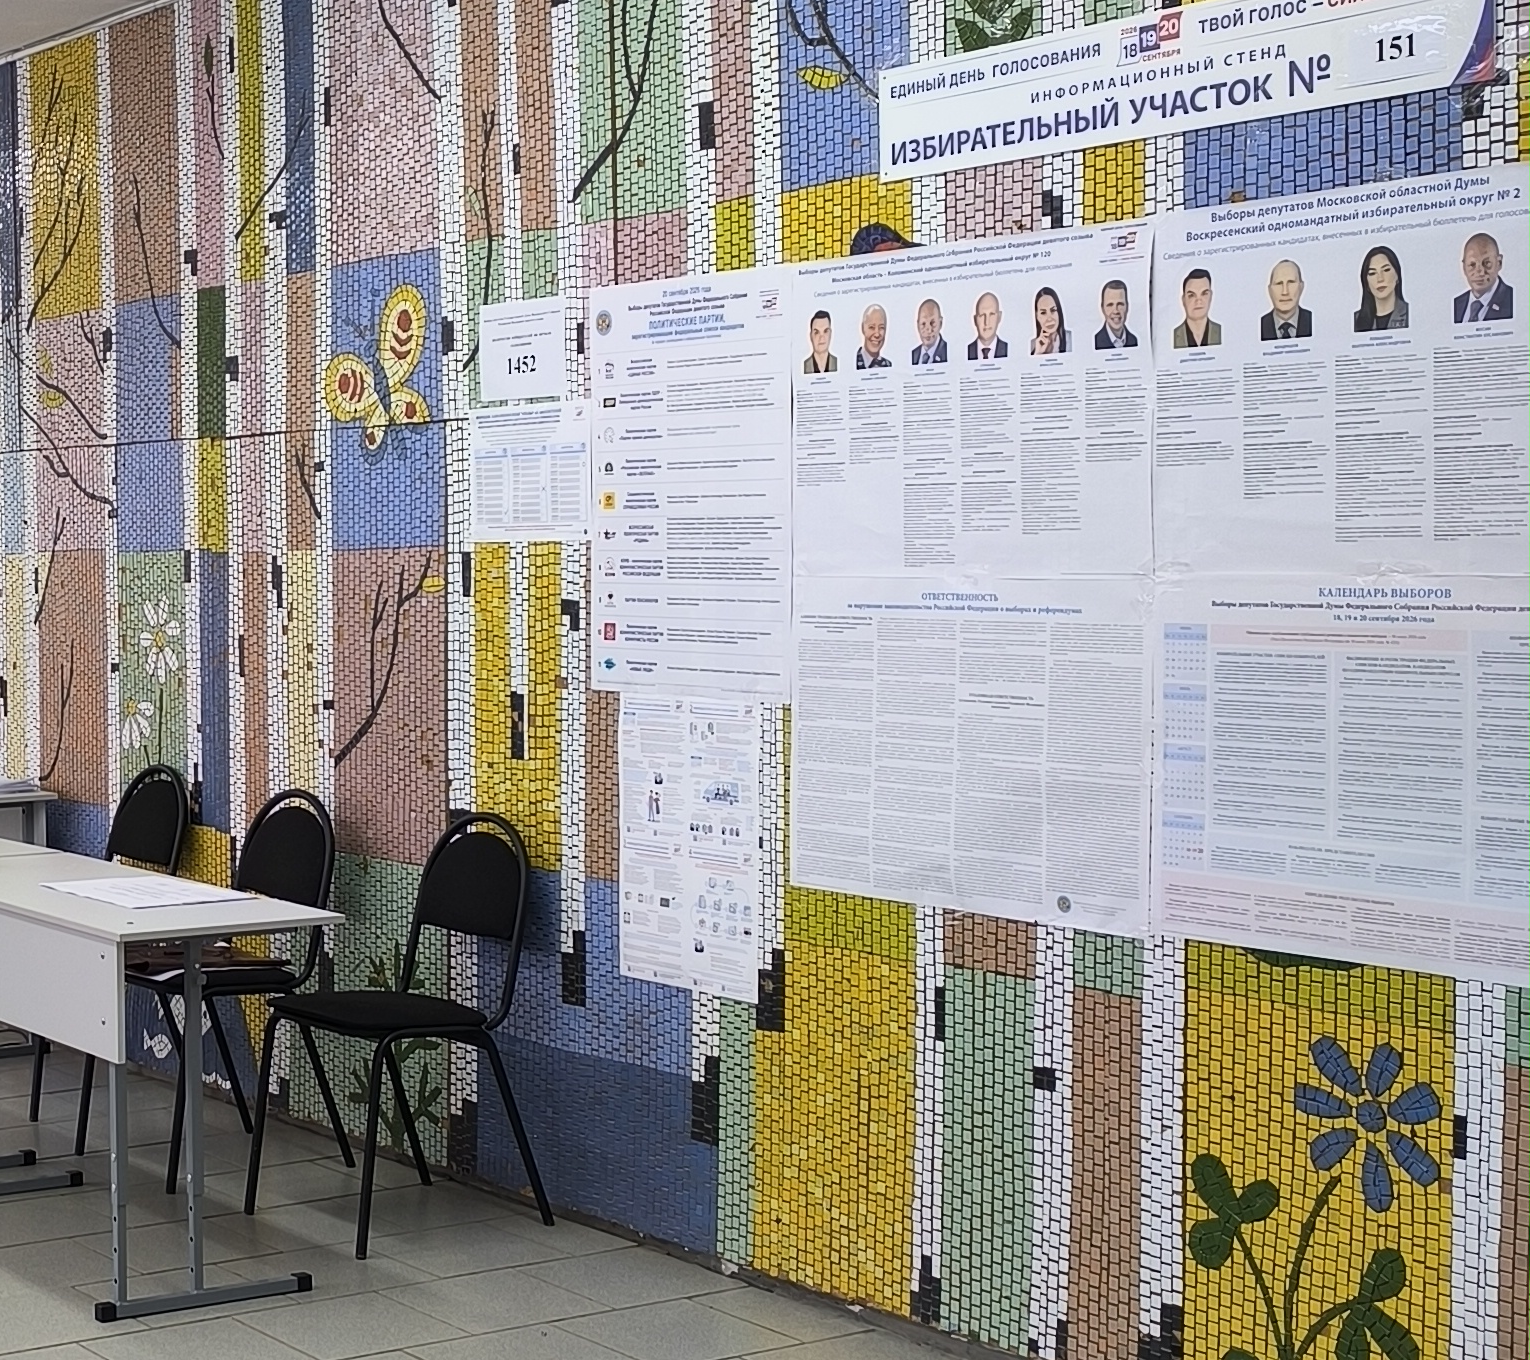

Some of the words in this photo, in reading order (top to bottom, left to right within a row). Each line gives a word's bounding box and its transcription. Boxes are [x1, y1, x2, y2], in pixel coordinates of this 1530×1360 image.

[1120, 25, 1138, 36] 2026
[1198, 8, 1244, 34] ТВОЙ
[1123, 43, 1138, 59] 18
[1140, 31, 1157, 48] 19
[1159, 18, 1179, 37] 20
[1142, 48, 1181, 62] СЕНТЯБРЯ
[890, 72, 945, 99] ЕДИНЫЙ
[949, 68, 985, 89] ДЕНЬ
[992, 42, 1101, 78] ГОЛОСОВАНИЯ
[1031, 56, 1214, 103] ИНФОРМАЦИОННЫЙ
[1224, 44, 1286, 66] СТЕНД
[891, 97, 1119, 165] ИЗБИРАТЕЛЬНЫЙ
[1129, 73, 1273, 124] УЧАСТОК
[1288, 53, 1331, 97] №
[1375, 33, 1416, 63] 151
[1211, 207, 1255, 223] Выборы
[1258, 201, 1315, 218] депутатов
[1316, 189, 1387, 208] Московской
[1389, 180, 1452, 198] областной
[1454, 176, 1490, 191] Думы
[1186, 222, 1266, 242] Воскресенский
[1268, 208, 1359, 232] одномандатный
[1361, 197, 1456, 219] избирательный
[1459, 193, 1494, 207] округ
[1497, 189, 1511, 201] №
[1513, 187, 1521, 199] 2
[1040, 250, 1052, 259] 120
[648, 315, 698, 330] ПОЛИТИЧЕСКИЕ
[507, 354, 537, 375] 1452
[921, 592, 999, 602] ОТВЕТСТВЕННОСТЬ
[1318, 587, 1388, 599] КАЛЕНДАРЬ
[1390, 588, 1452, 599] ВЫБОРОВ
[1401, 615, 1418, 623] 2026
